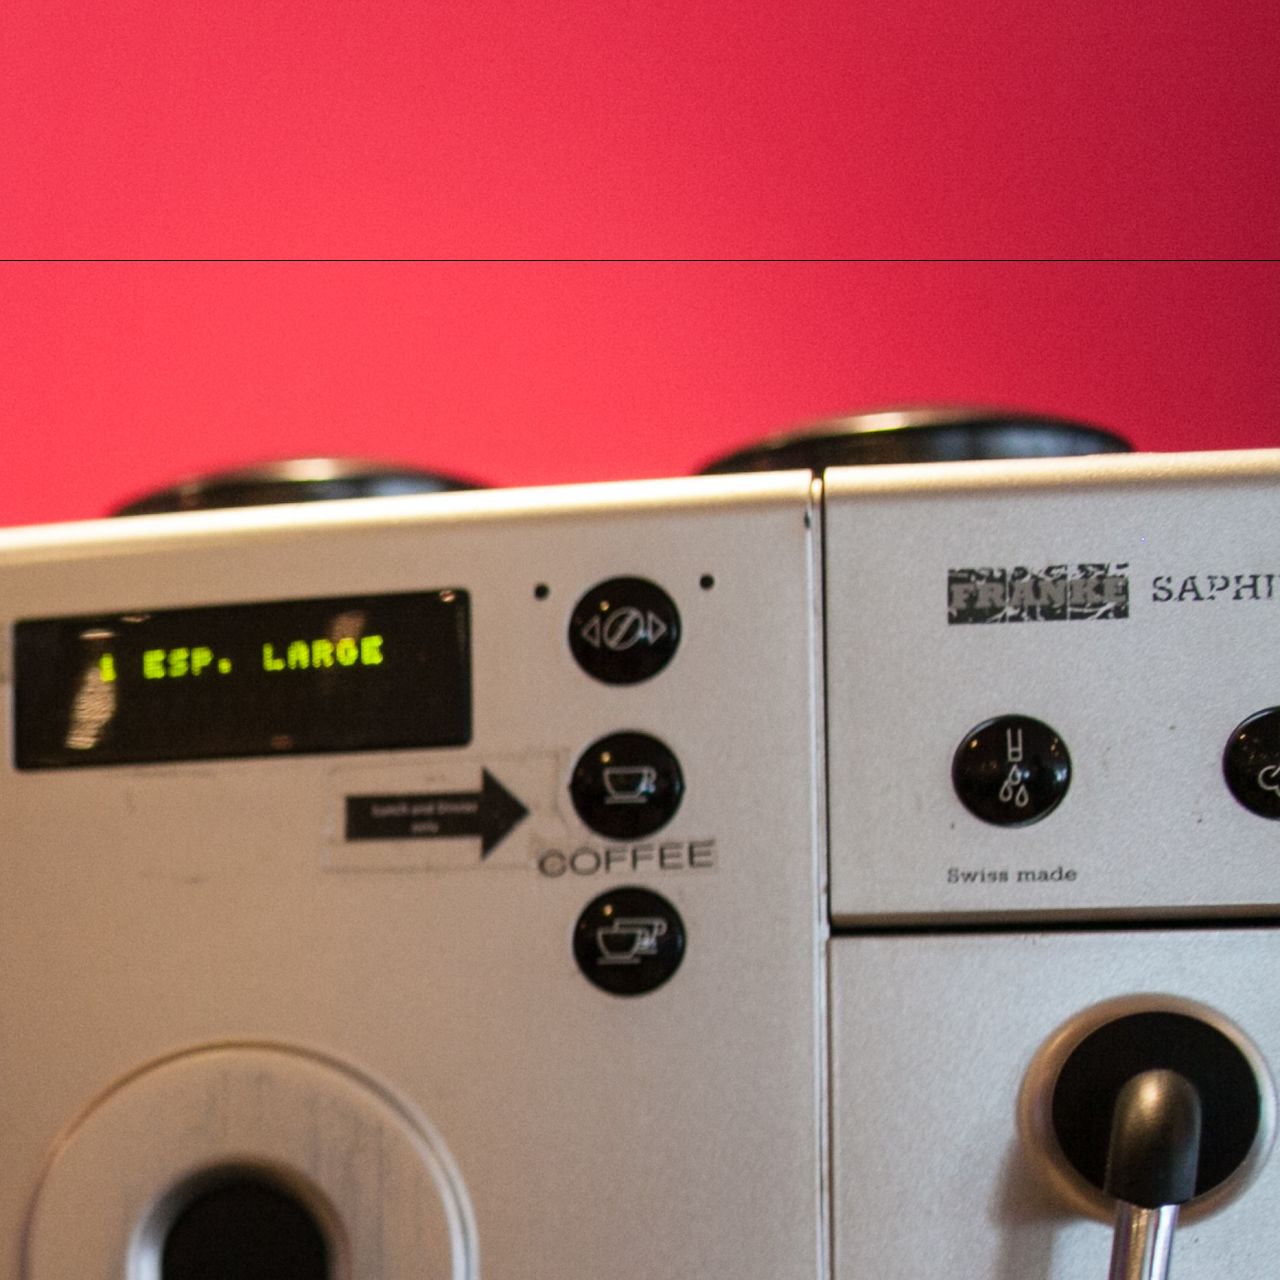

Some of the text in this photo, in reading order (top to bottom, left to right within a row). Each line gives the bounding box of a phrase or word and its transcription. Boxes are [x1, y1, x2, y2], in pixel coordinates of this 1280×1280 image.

[949, 570, 1129, 616] FRANKE
[143, 646, 232, 679] ESP.
[263, 634, 383, 672] LARGE
[538, 838, 716, 879] COFFEE
[947, 866, 1078, 884] Swiss made
